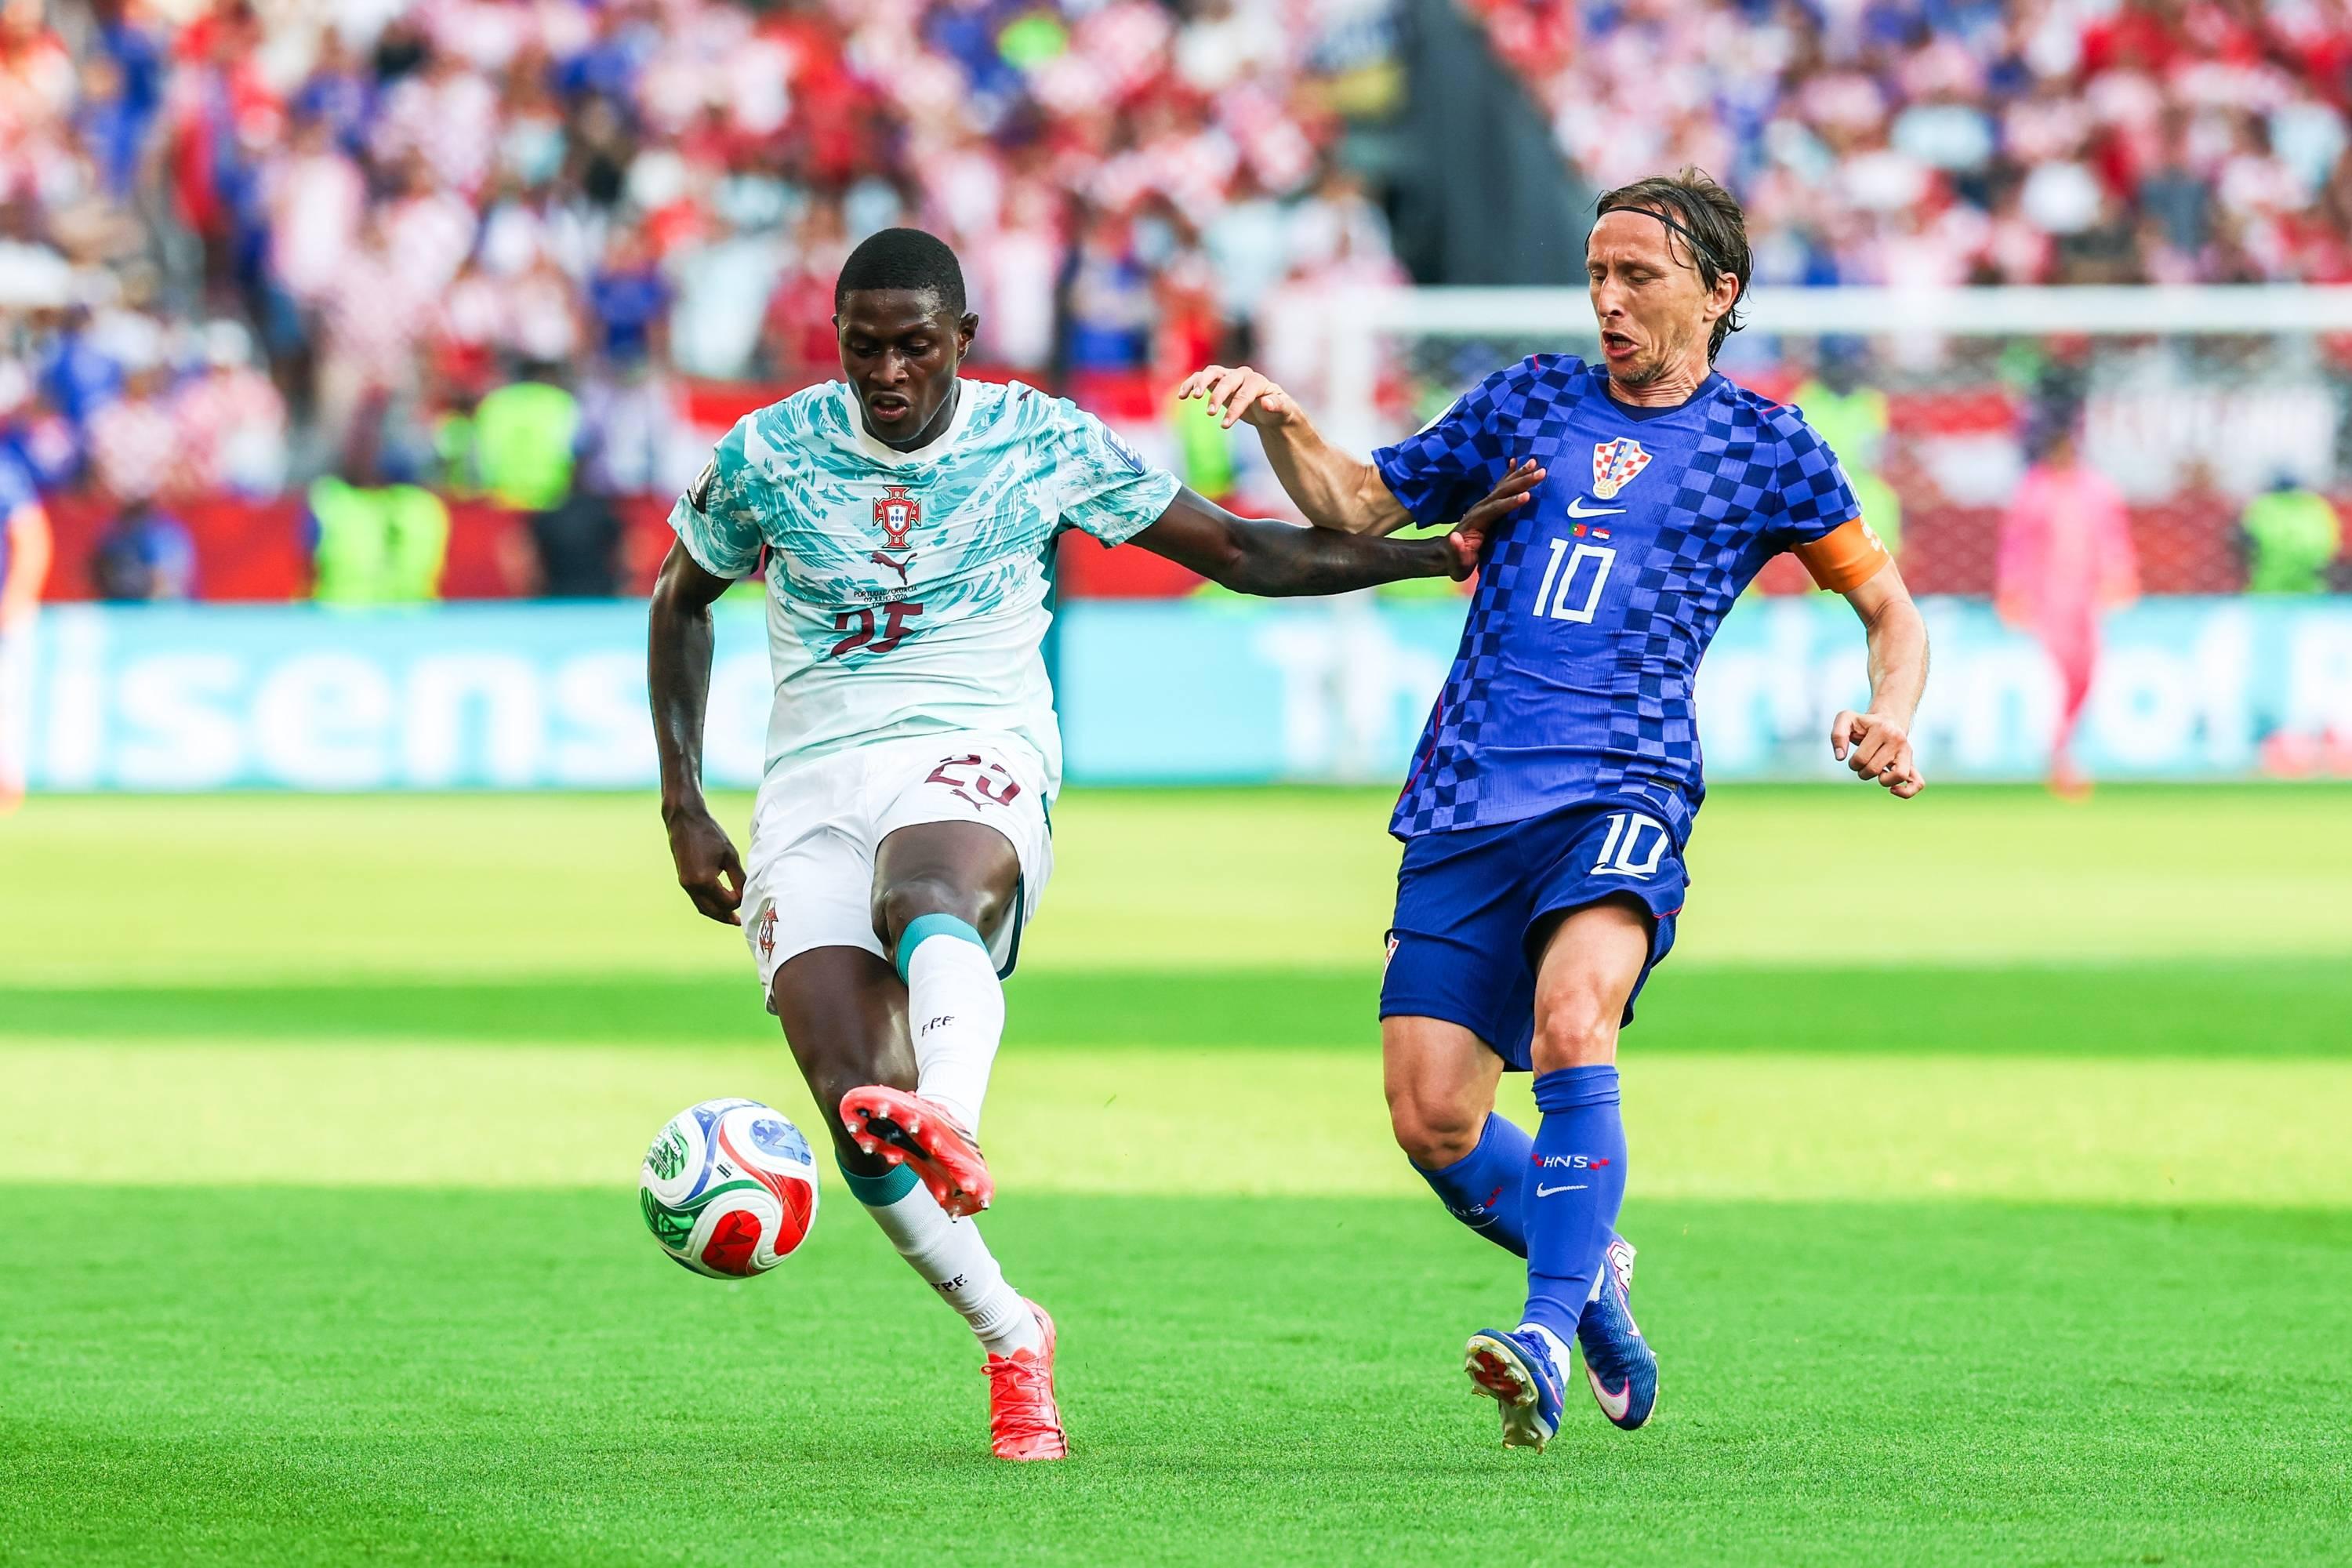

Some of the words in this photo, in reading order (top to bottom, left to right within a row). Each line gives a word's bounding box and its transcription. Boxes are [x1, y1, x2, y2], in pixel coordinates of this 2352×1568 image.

[1532, 537, 1617, 624] 10
[830, 601, 924, 656] 25
[1596, 812, 1669, 874] 10
[1543, 1155, 1588, 1168] HNS
